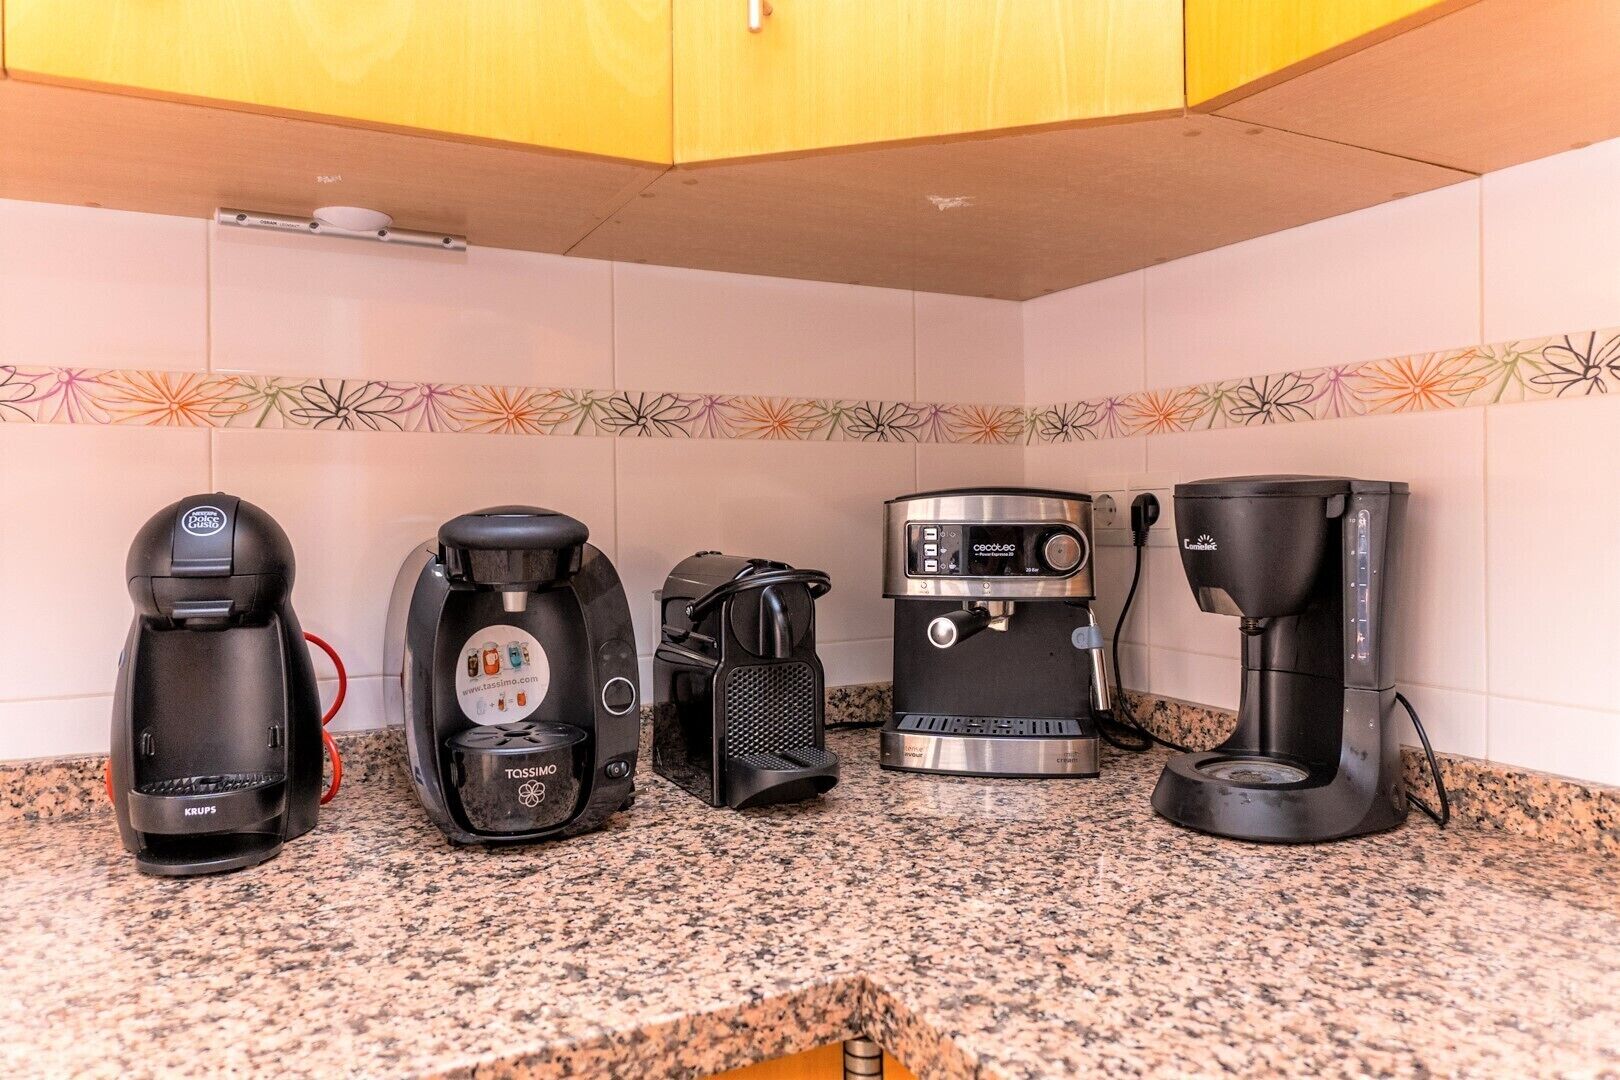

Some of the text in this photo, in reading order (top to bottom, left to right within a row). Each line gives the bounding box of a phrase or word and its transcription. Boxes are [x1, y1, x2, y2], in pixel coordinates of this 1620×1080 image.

[189, 514, 219, 523] Dolce
[188, 521, 219, 529] Gusto
[462, 676, 539, 696] www.tassimo.com
[184, 805, 217, 817] KRUPS
